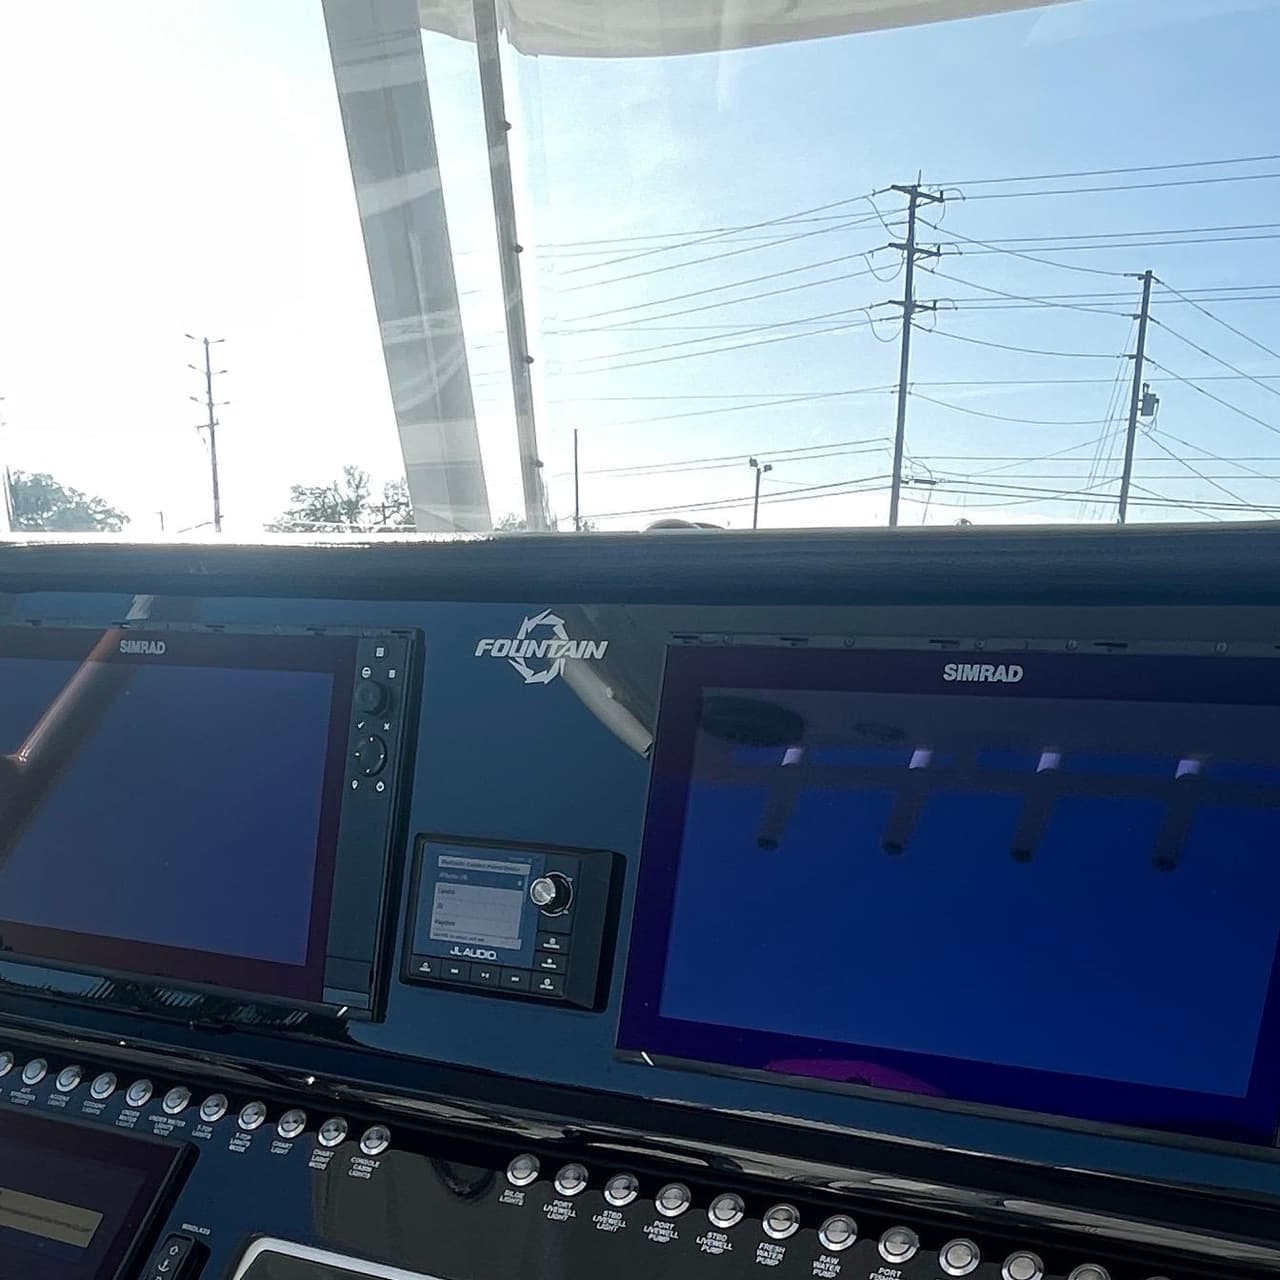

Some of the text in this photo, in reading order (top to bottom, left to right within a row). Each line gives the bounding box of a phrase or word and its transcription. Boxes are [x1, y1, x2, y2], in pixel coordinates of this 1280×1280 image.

[120, 640, 166, 654] SIMRAD
[475, 639, 608, 659] FOUNTAIN
[943, 664, 1023, 682] SIMRAD
[450, 946, 497, 960] JL AUDIO
[543, 1205, 576, 1218] LIVEWELL
[592, 1215, 627, 1228] LIVEWELL
[653, 1220, 675, 1231] PORT
[643, 1225, 679, 1240] LIVEWELL
[696, 1236, 733, 1250] LIVEWELL
[758, 1242, 786, 1254] FRESH
[755, 1256, 780, 1266] PUMP
[757, 1249, 784, 1261] WATER
[819, 1255, 840, 1265] RAW
[813, 1261, 841, 1273] WATER
[878, 1267, 902, 1279] PORT
[812, 1268, 837, 1279] PUMP
